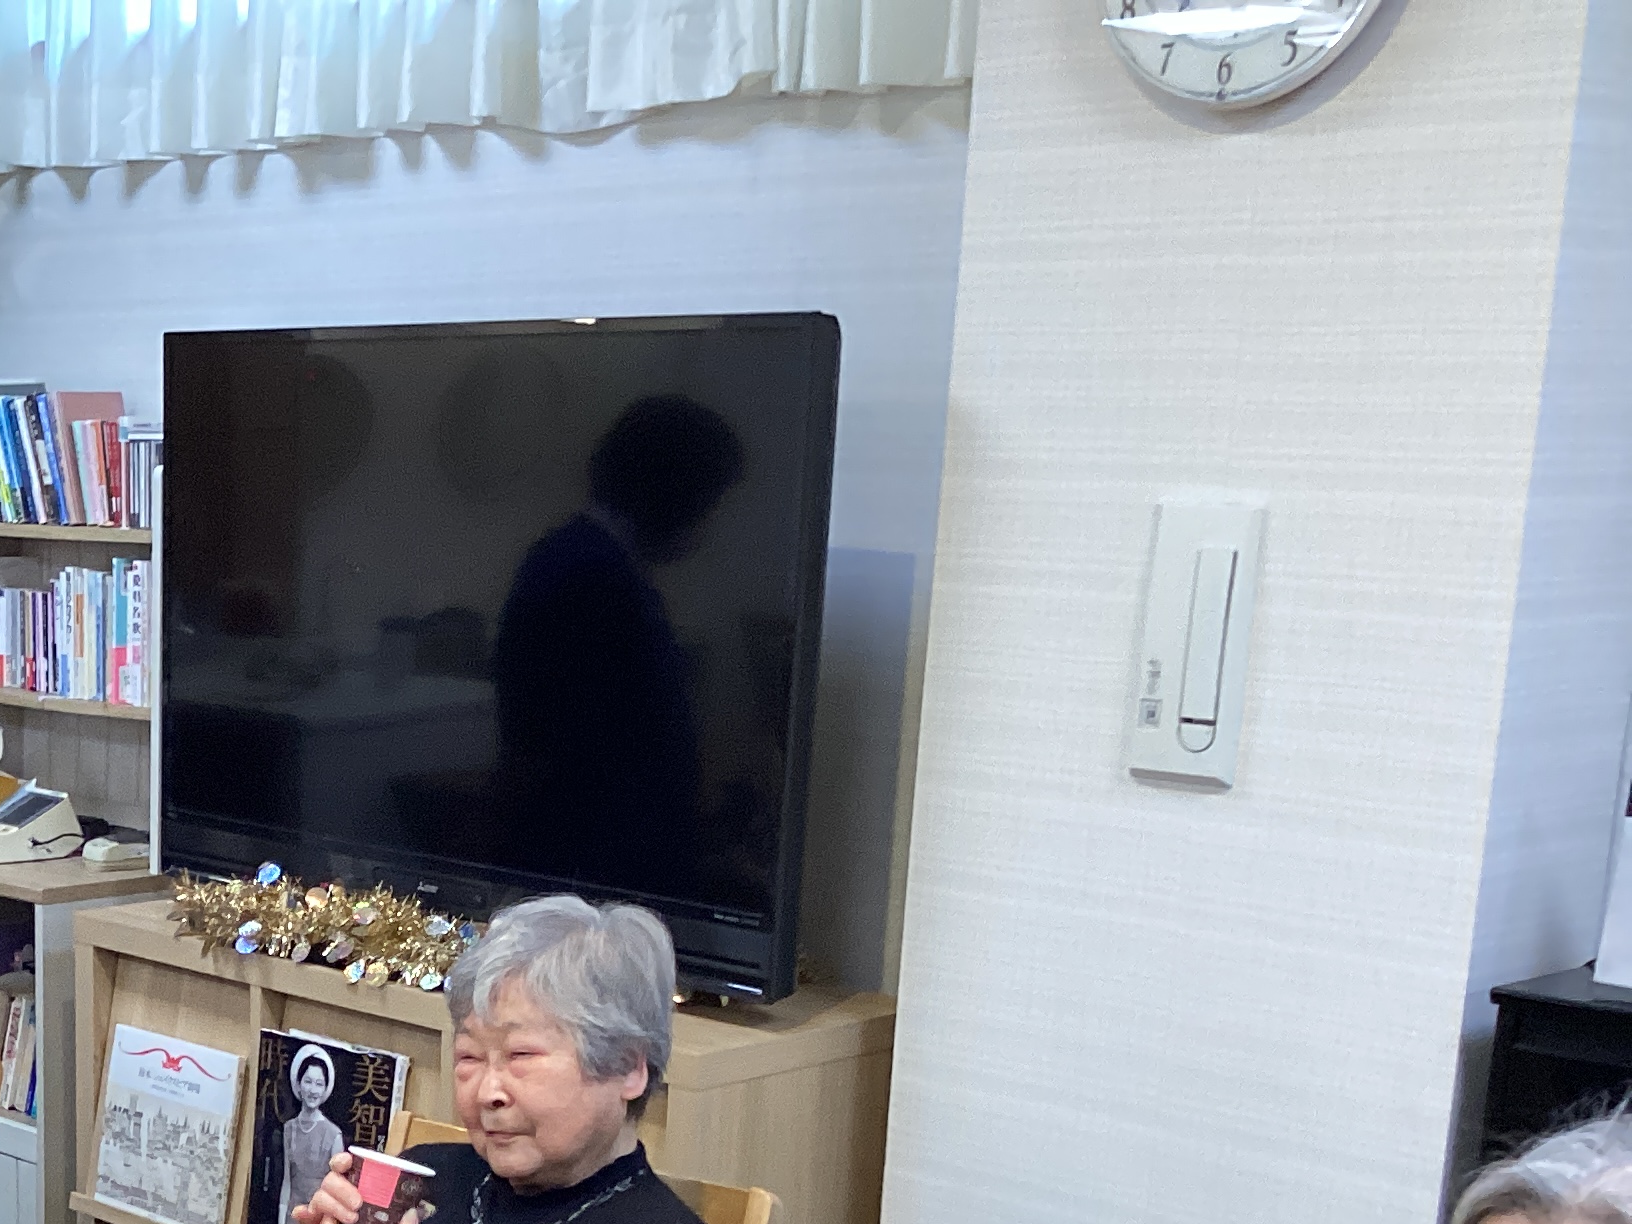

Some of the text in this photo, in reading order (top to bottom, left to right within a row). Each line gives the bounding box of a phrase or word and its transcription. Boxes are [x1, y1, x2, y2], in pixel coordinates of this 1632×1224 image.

[1160, 41, 1176, 77] 7
[1281, 29, 1299, 67] 5
[1216, 51, 1233, 85] 6
